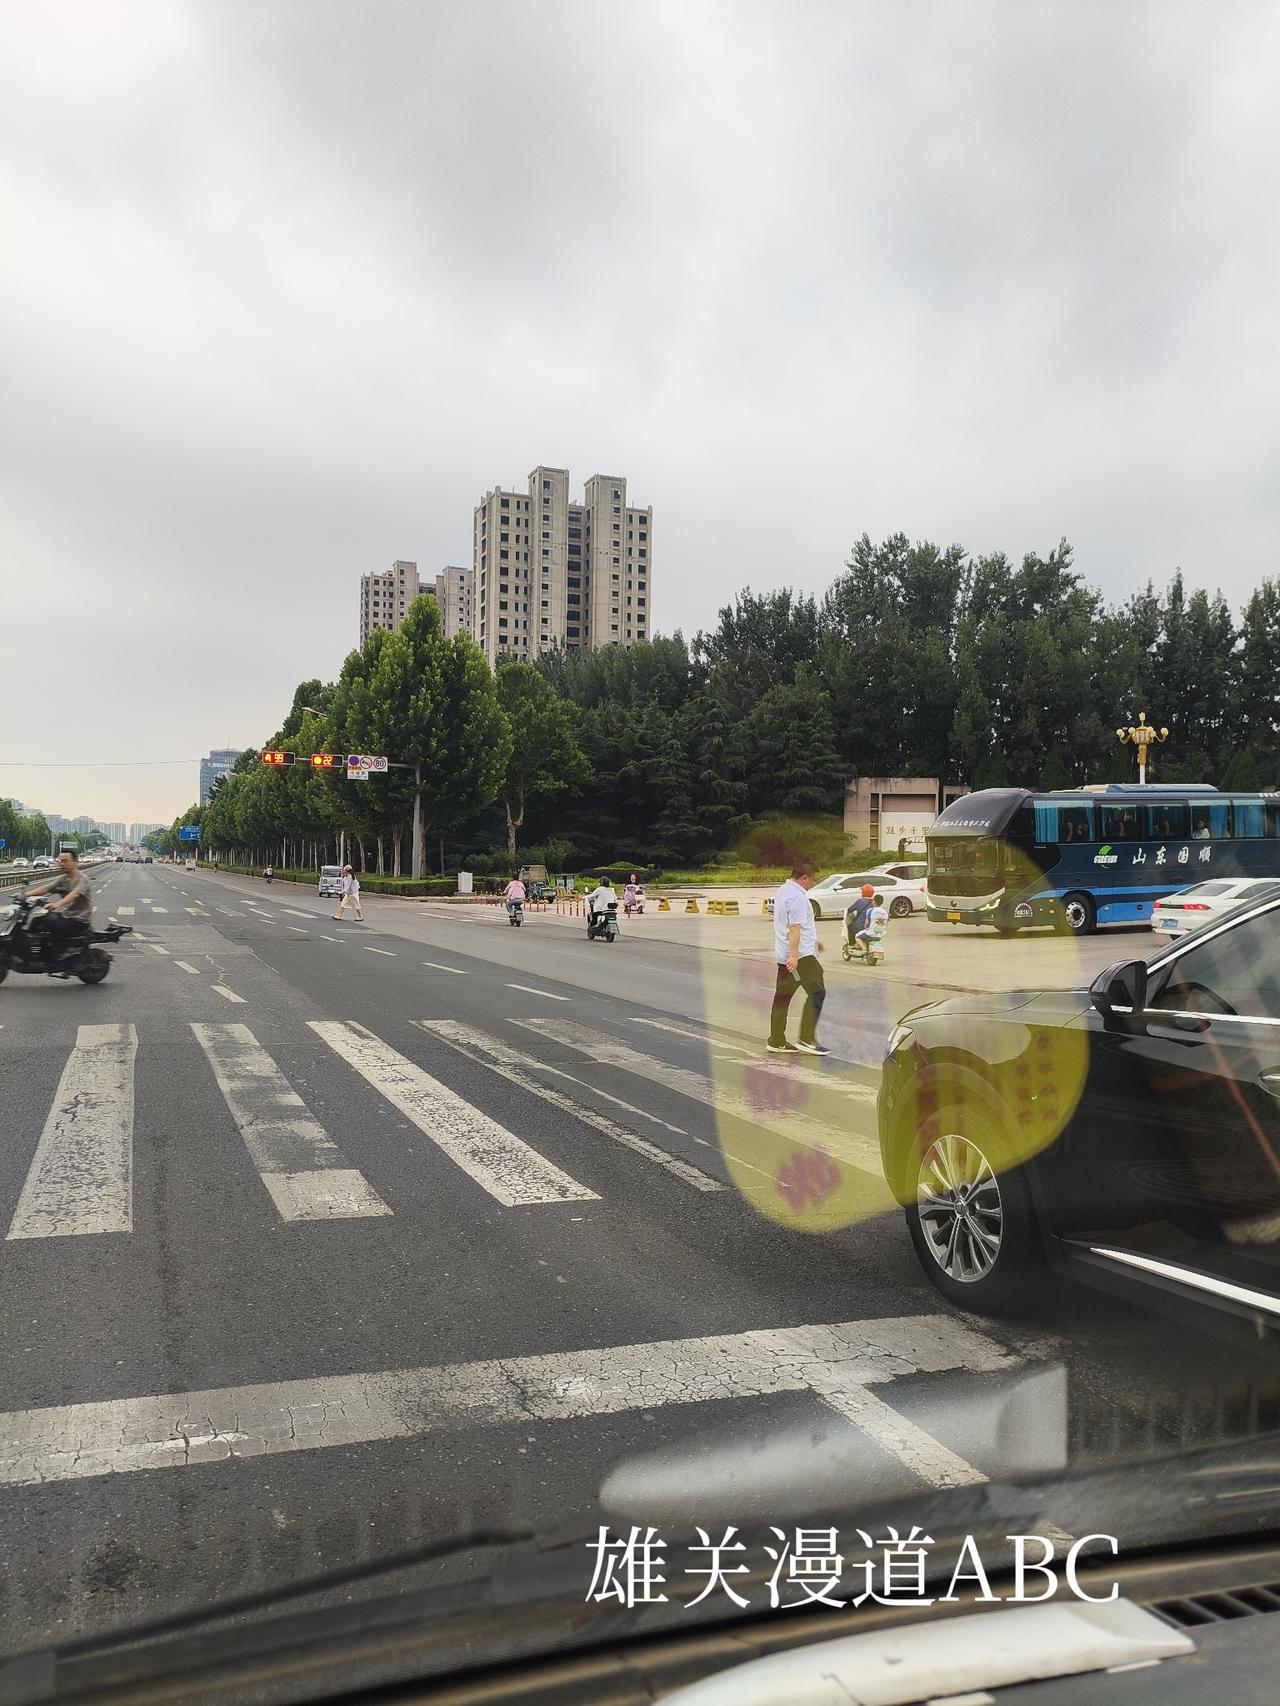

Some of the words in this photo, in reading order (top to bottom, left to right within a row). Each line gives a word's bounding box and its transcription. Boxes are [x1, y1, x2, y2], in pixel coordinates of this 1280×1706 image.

[322, 756, 333, 766] 22
[375, 759, 385, 768] 80
[1132, 845, 1212, 866] 山东国顺
